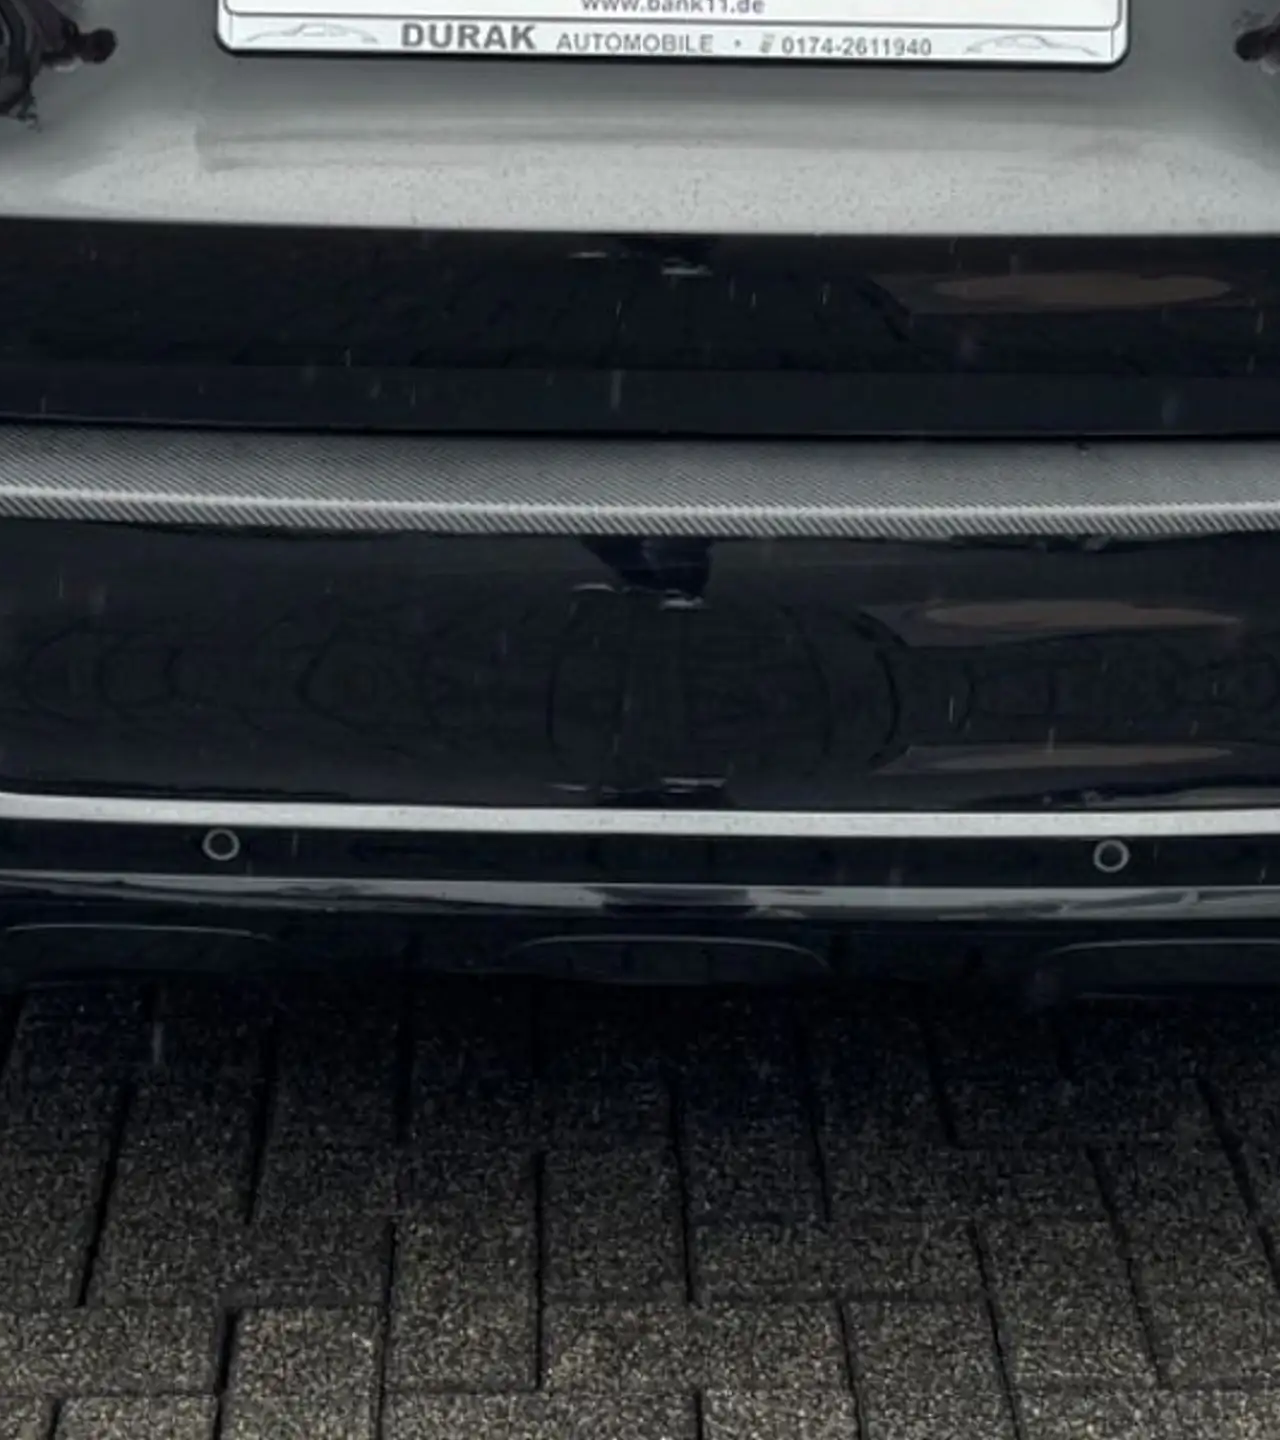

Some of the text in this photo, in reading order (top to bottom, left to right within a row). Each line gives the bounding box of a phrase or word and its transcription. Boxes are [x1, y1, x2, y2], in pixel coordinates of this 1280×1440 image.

[401, 23, 933, 57] DURAK AUTOMOBILE 0174-2611940
